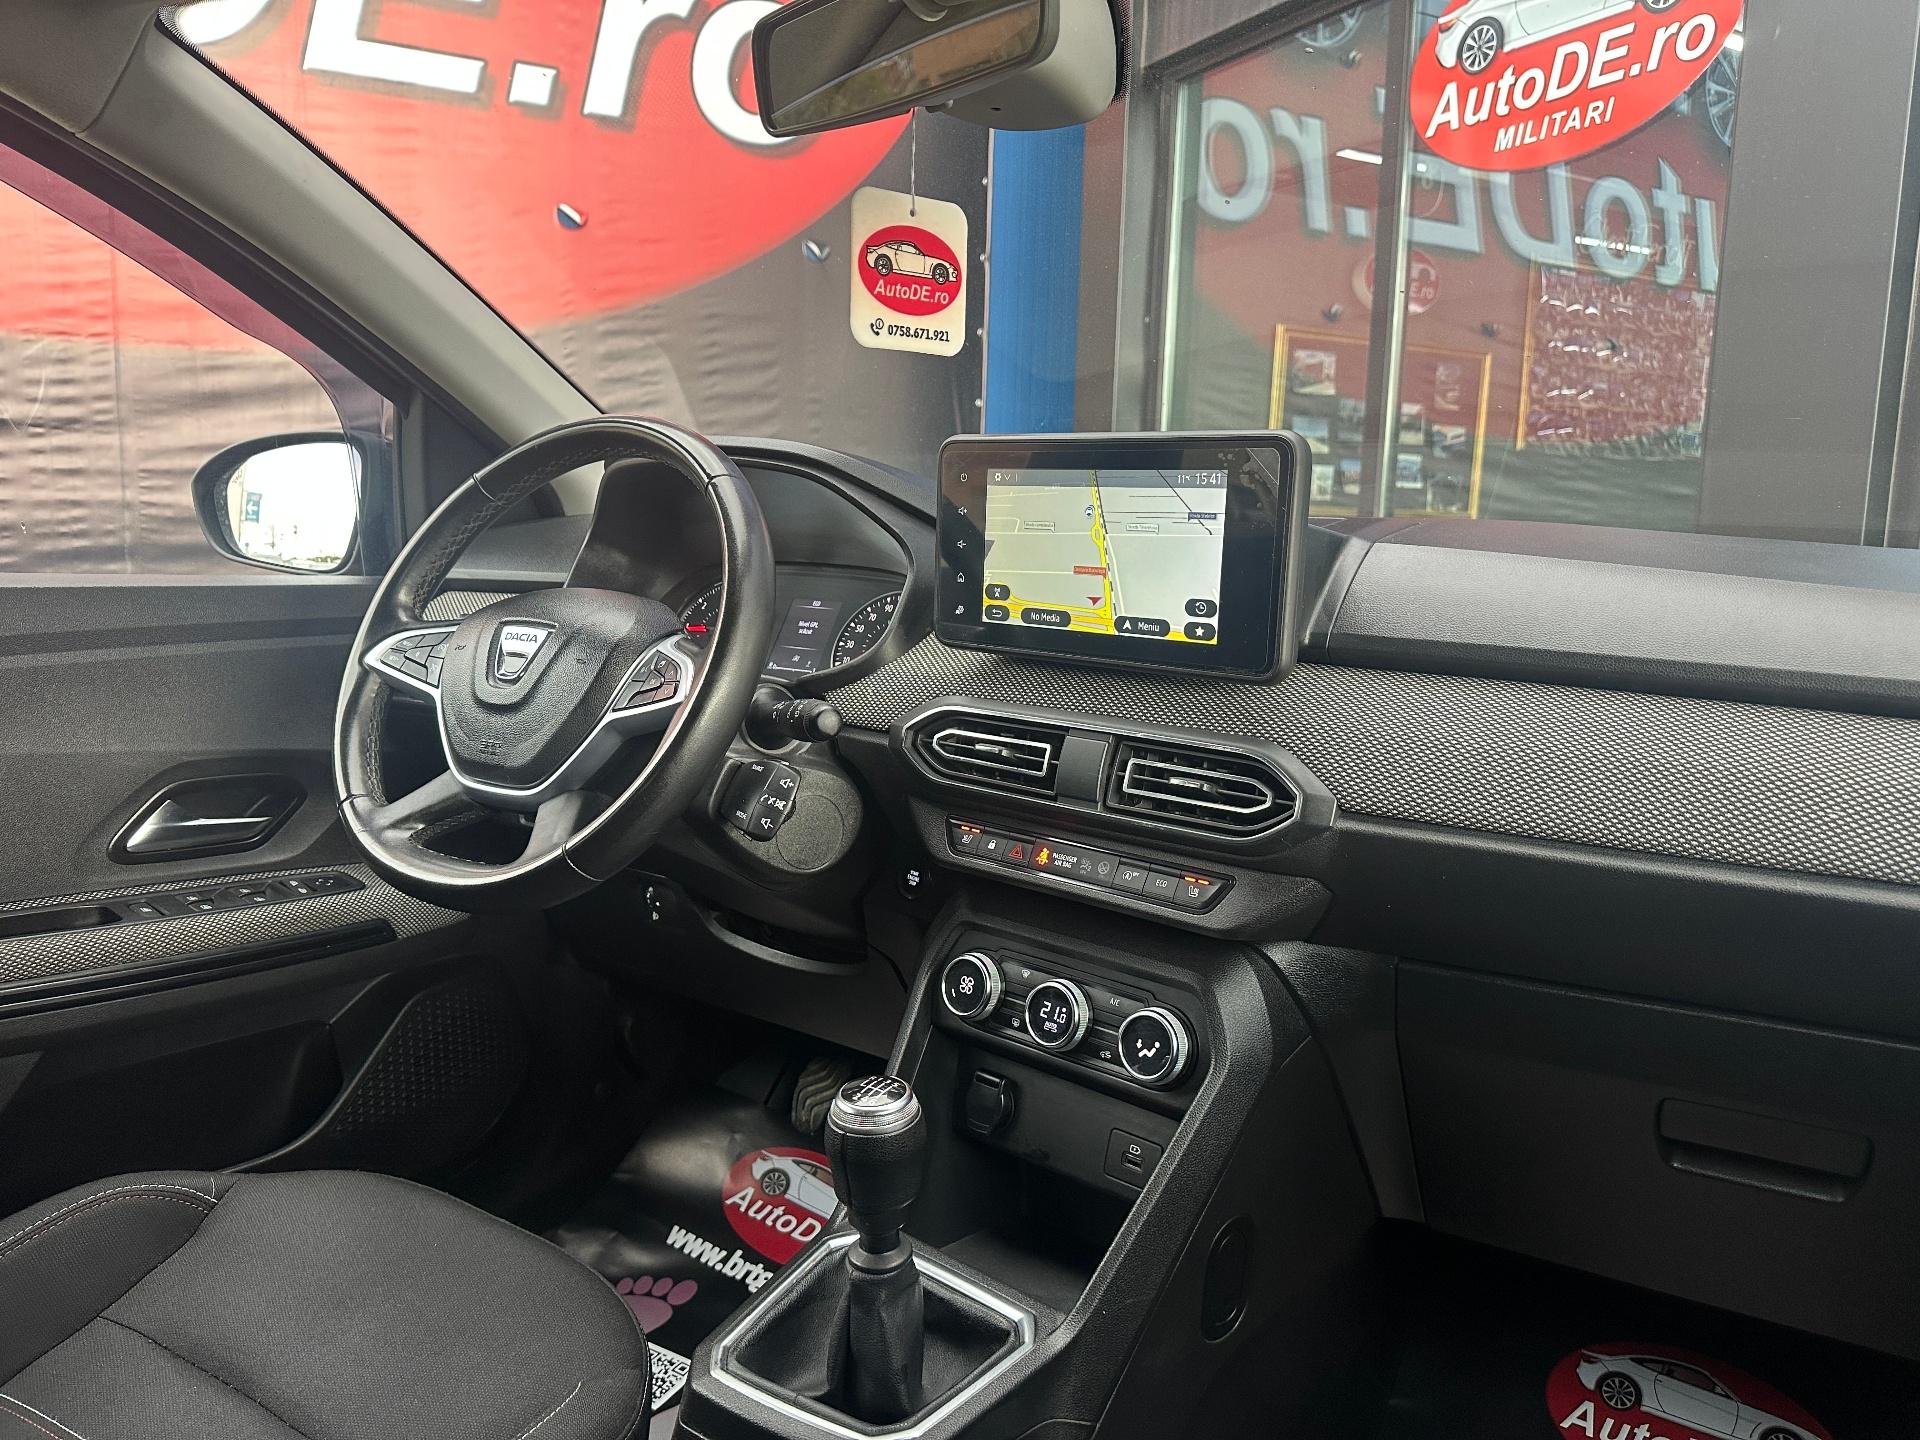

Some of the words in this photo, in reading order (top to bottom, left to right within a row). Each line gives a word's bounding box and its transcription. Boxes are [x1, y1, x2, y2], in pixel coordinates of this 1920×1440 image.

[1425, 12, 1716, 138] AutoDE.ro
[1494, 97, 1615, 153] MILITARI
[873, 279, 949, 305] AutoDE.ro
[887, 324, 950, 342] 0758.671.921
[884, 604, 894, 613] 90
[868, 612, 877, 622] 70
[1030, 612, 1041, 622] No
[1041, 612, 1061, 624] Media
[854, 624, 865, 633] 50
[1137, 621, 1160, 633] Meniu
[504, 632, 539, 645] DACIA
[844, 639, 855, 649] 30
[1052, 852, 1078, 864] PASSENGER
[1155, 879, 1168, 888] ECO
[1109, 997, 1121, 1007] A/C
